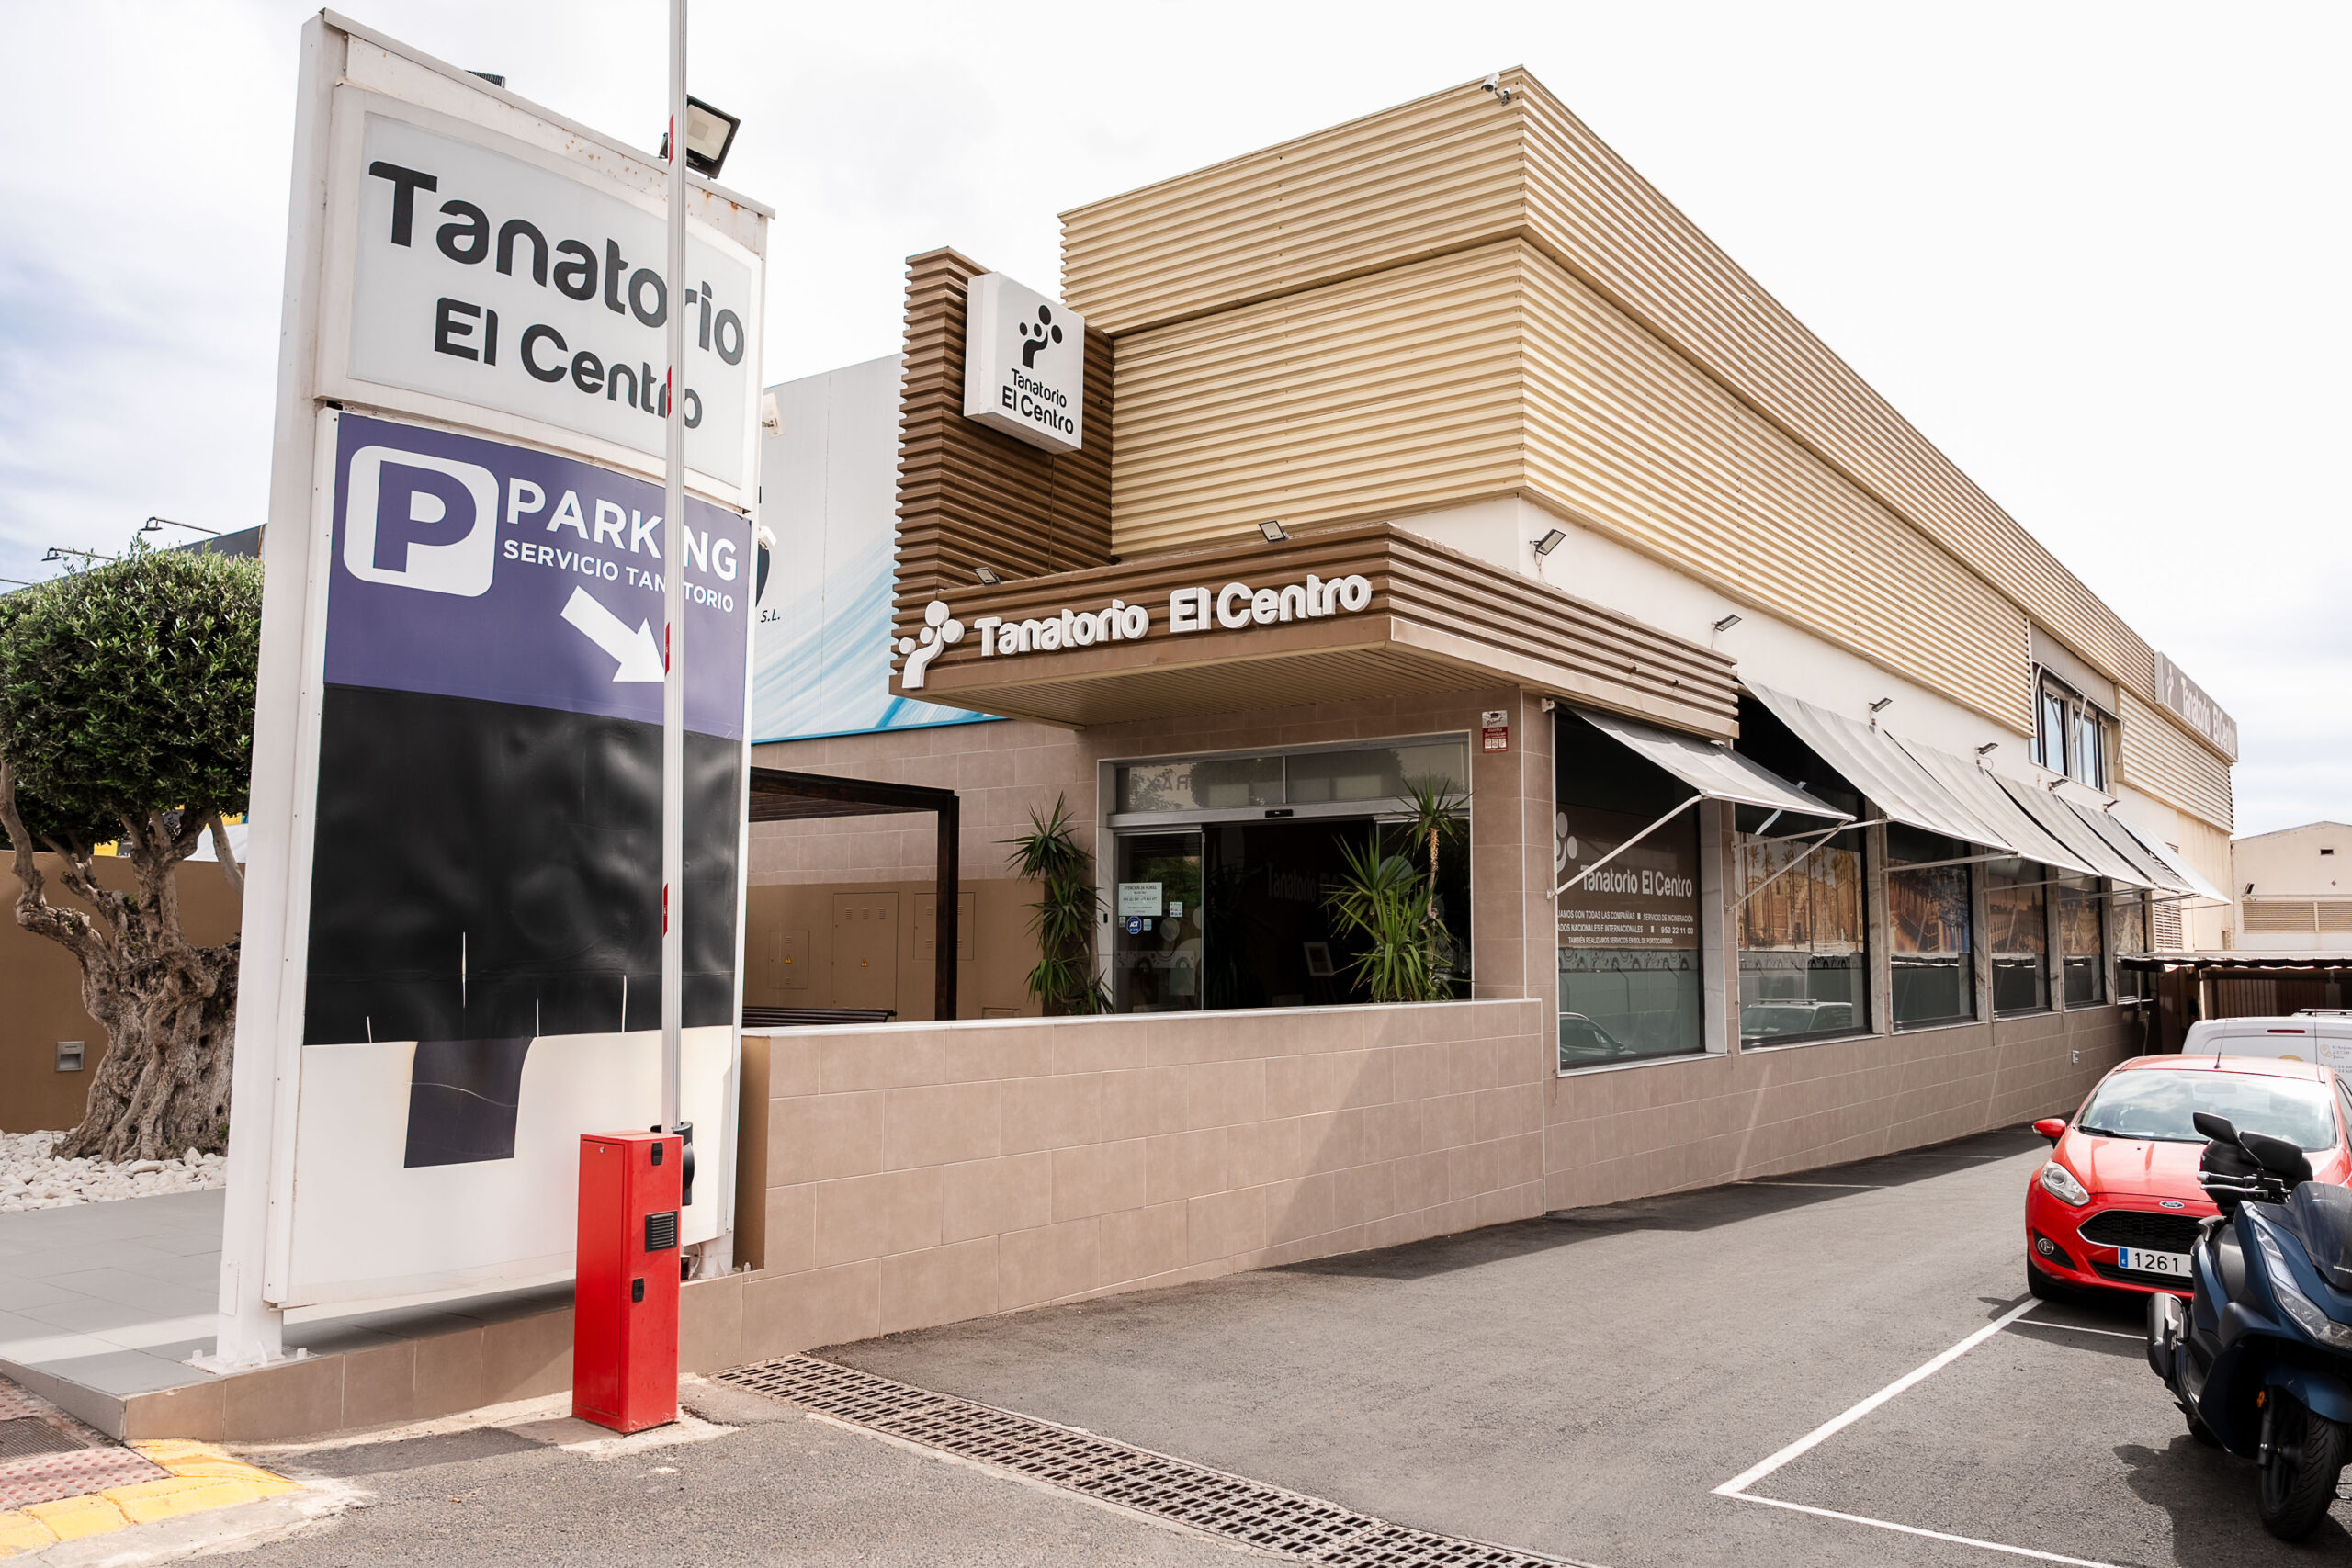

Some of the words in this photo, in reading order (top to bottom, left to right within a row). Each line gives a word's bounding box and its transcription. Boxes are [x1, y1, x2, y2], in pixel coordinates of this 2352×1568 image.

[435, 298, 498, 366] El
[1002, 385, 1017, 412] El
[1021, 394, 1074, 434] Centro
[1011, 367, 1068, 408] Tanatorio
[373, 460, 478, 573] P
[506, 477, 738, 581] PARKNG
[503, 539, 619, 581] SERVICIO
[626, 566, 735, 613] TANTORIO
[760, 608, 781, 623] S.L.
[974, 599, 1150, 657] Tanatorio
[1170, 586, 1212, 634] El
[1216, 574, 1373, 630] Centro
[1580, 865, 1638, 894] Tanatorio
[1642, 870, 1654, 895] El
[1655, 871, 1692, 897] Centro
[1571, 924, 1600, 932] NACIONALES
[1600, 924, 1604, 932] E
[1604, 924, 1643, 933] INTERNACIONALES
[1661, 926, 1671, 934] 950
[1672, 926, 1679, 934] 22
[1575, 910, 1585, 919] CON
[1586, 910, 1601, 919] TODAS
[1644, 913, 1661, 921] SERVICIO
[2134, 1252, 2178, 1273] 1261
